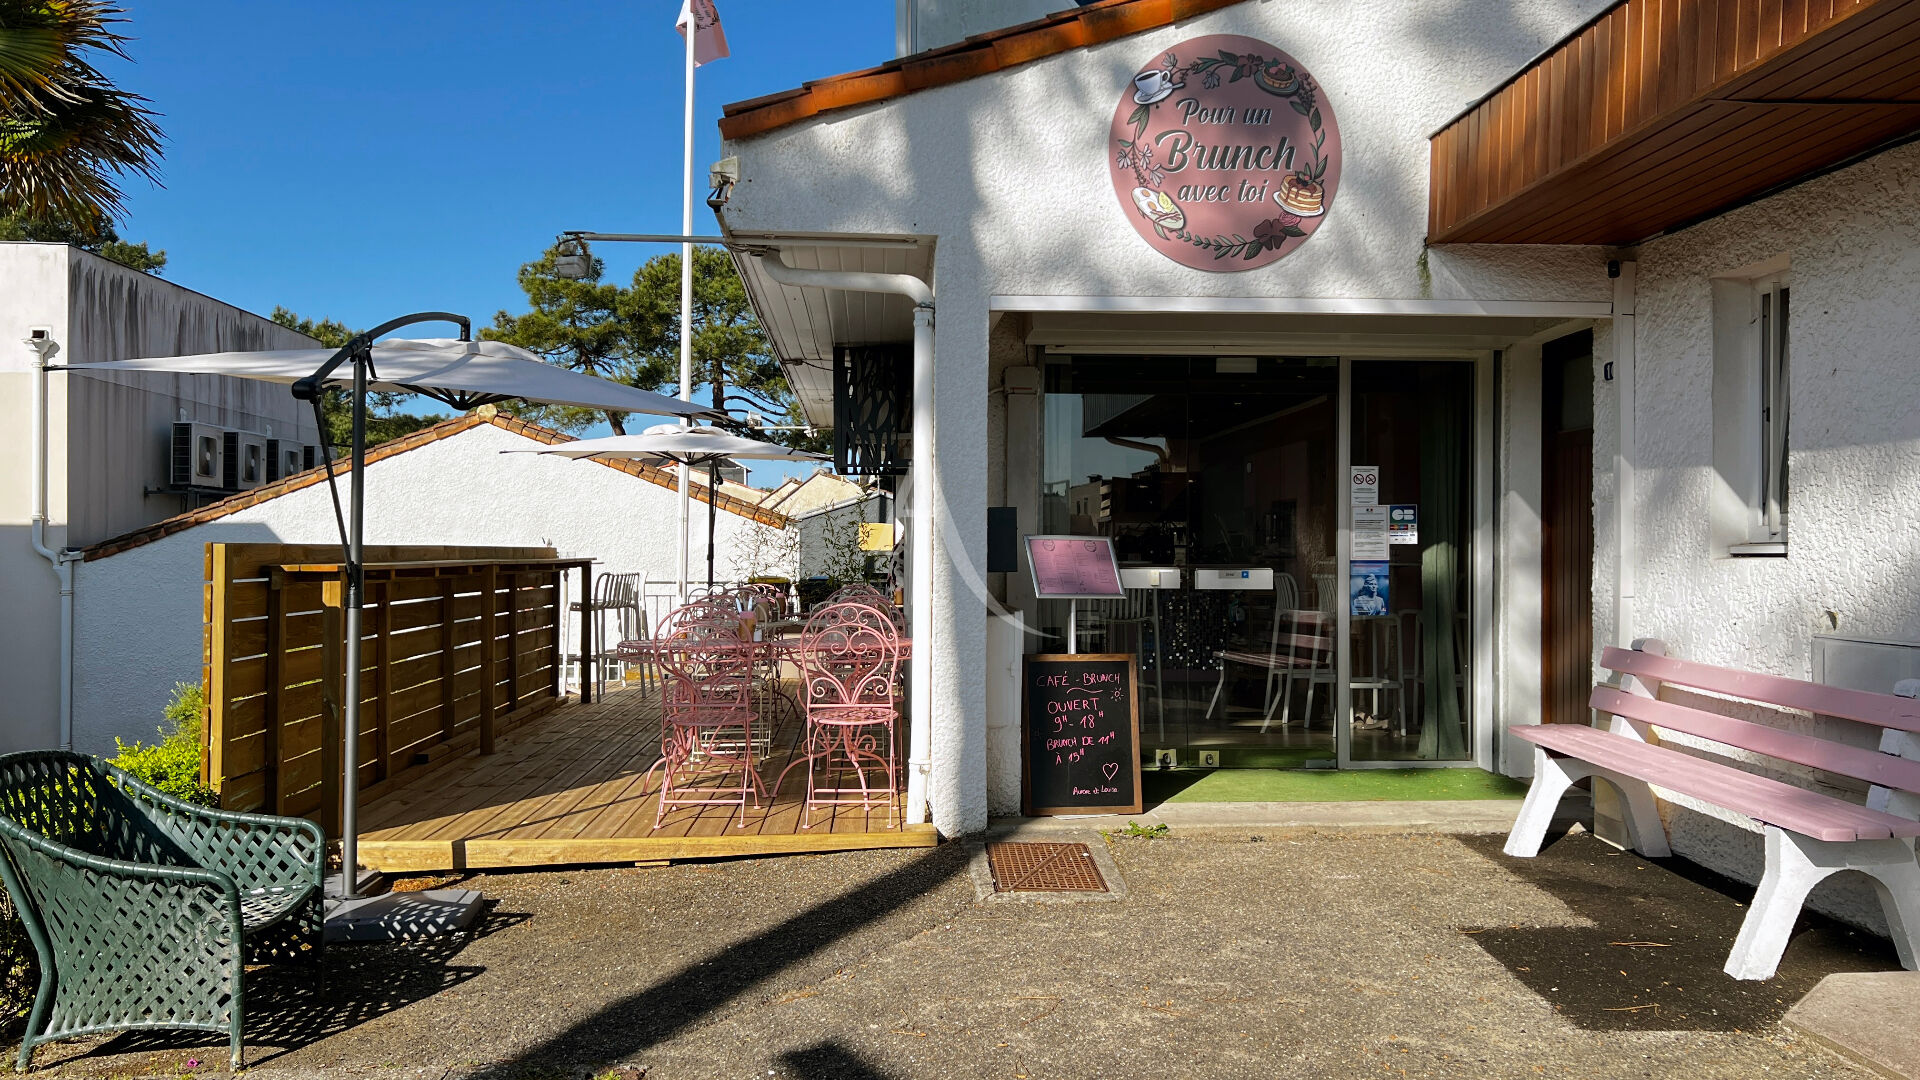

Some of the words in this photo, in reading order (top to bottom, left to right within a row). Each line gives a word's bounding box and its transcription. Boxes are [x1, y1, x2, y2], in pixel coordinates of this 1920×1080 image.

[1176, 97, 1237, 127] Pour
[1243, 107, 1273, 125] un
[1154, 129, 1297, 174] Brunch
[1177, 183, 1231, 203] avec
[1237, 179, 1269, 203] toi
[1036, 670, 1070, 688] CAFÉ
[1082, 673, 1120, 686] BRUNCH
[1047, 697, 1100, 714] OUVERT
[1046, 736, 1077, 751] BRUNCH
[1082, 736, 1095, 746] DE
